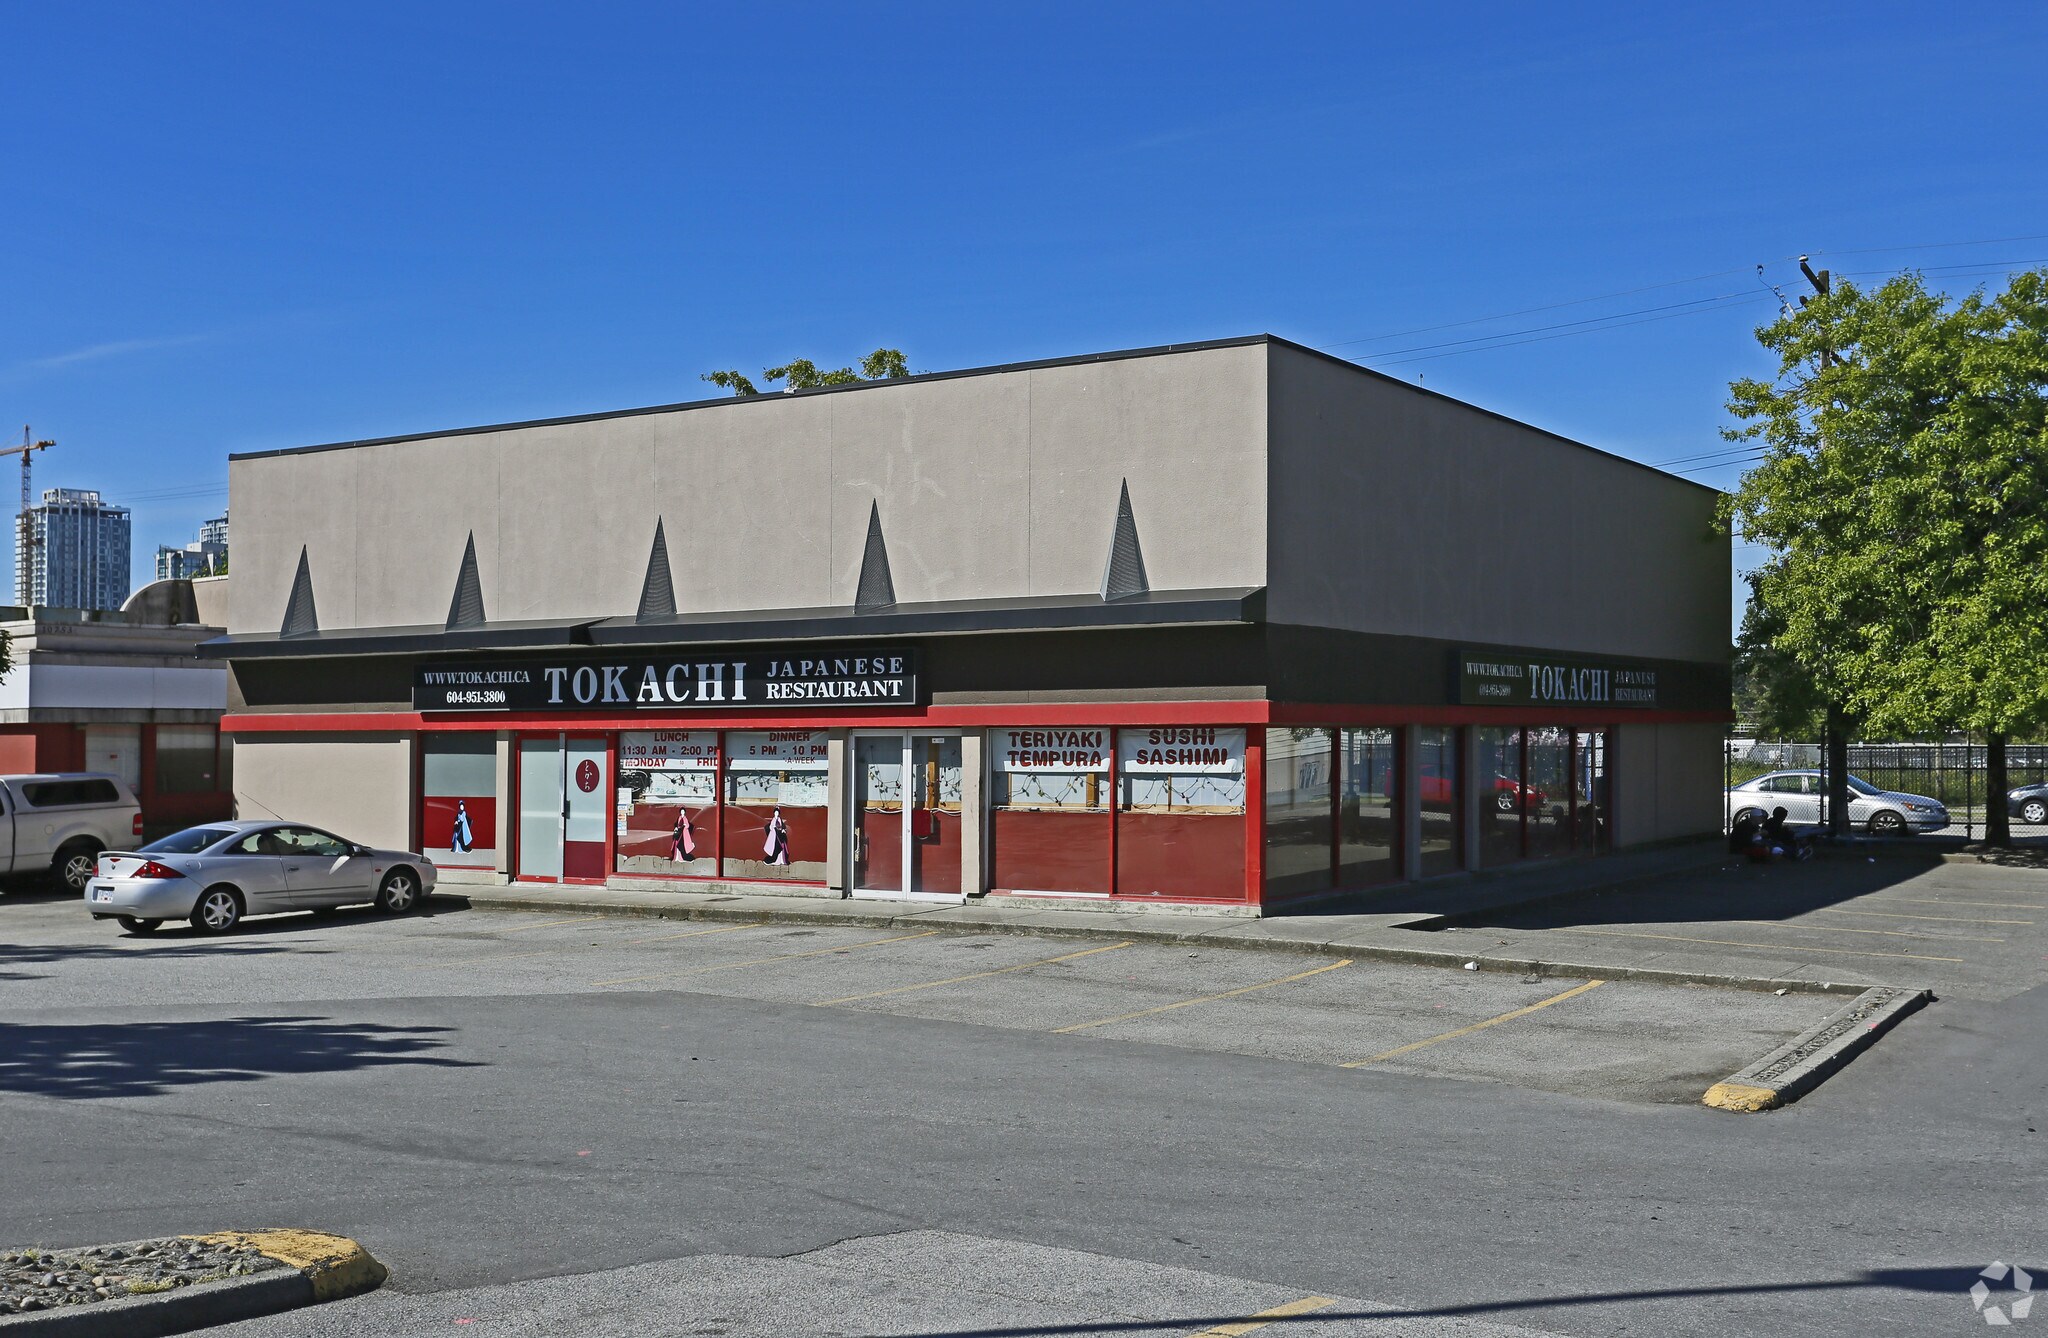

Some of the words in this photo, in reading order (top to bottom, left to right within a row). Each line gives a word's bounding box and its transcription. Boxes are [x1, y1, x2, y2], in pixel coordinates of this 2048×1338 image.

[766, 657, 904, 677] JAPANESE
[424, 670, 531, 684] WWW.TOKACHI.CA
[544, 662, 747, 703] TOKACHI
[1528, 664, 1610, 702] TOKACHI
[1614, 671, 1656, 685] JAPANESE
[446, 690, 506, 703] 604-951-3800
[766, 679, 903, 700] RESTAURANT
[1614, 688, 1656, 701] RESTAURANT
[654, 732, 689, 742] LUNCH
[769, 732, 811, 742] DINNER
[1007, 731, 1103, 748] TERIYAKI
[1148, 729, 1216, 746] SUSHI
[622, 745, 647, 755] 11:30
[651, 745, 667, 755] AM
[680, 745, 702, 756] 2:00
[749, 745, 756, 755] 5
[761, 745, 777, 755] PM
[792, 745, 805, 755] 10
[810, 745, 827, 755] PM
[1136, 748, 1228, 765] SASHIMI
[794, 756, 816, 764] WEEK
[1007, 750, 1102, 767] TEMPURA
